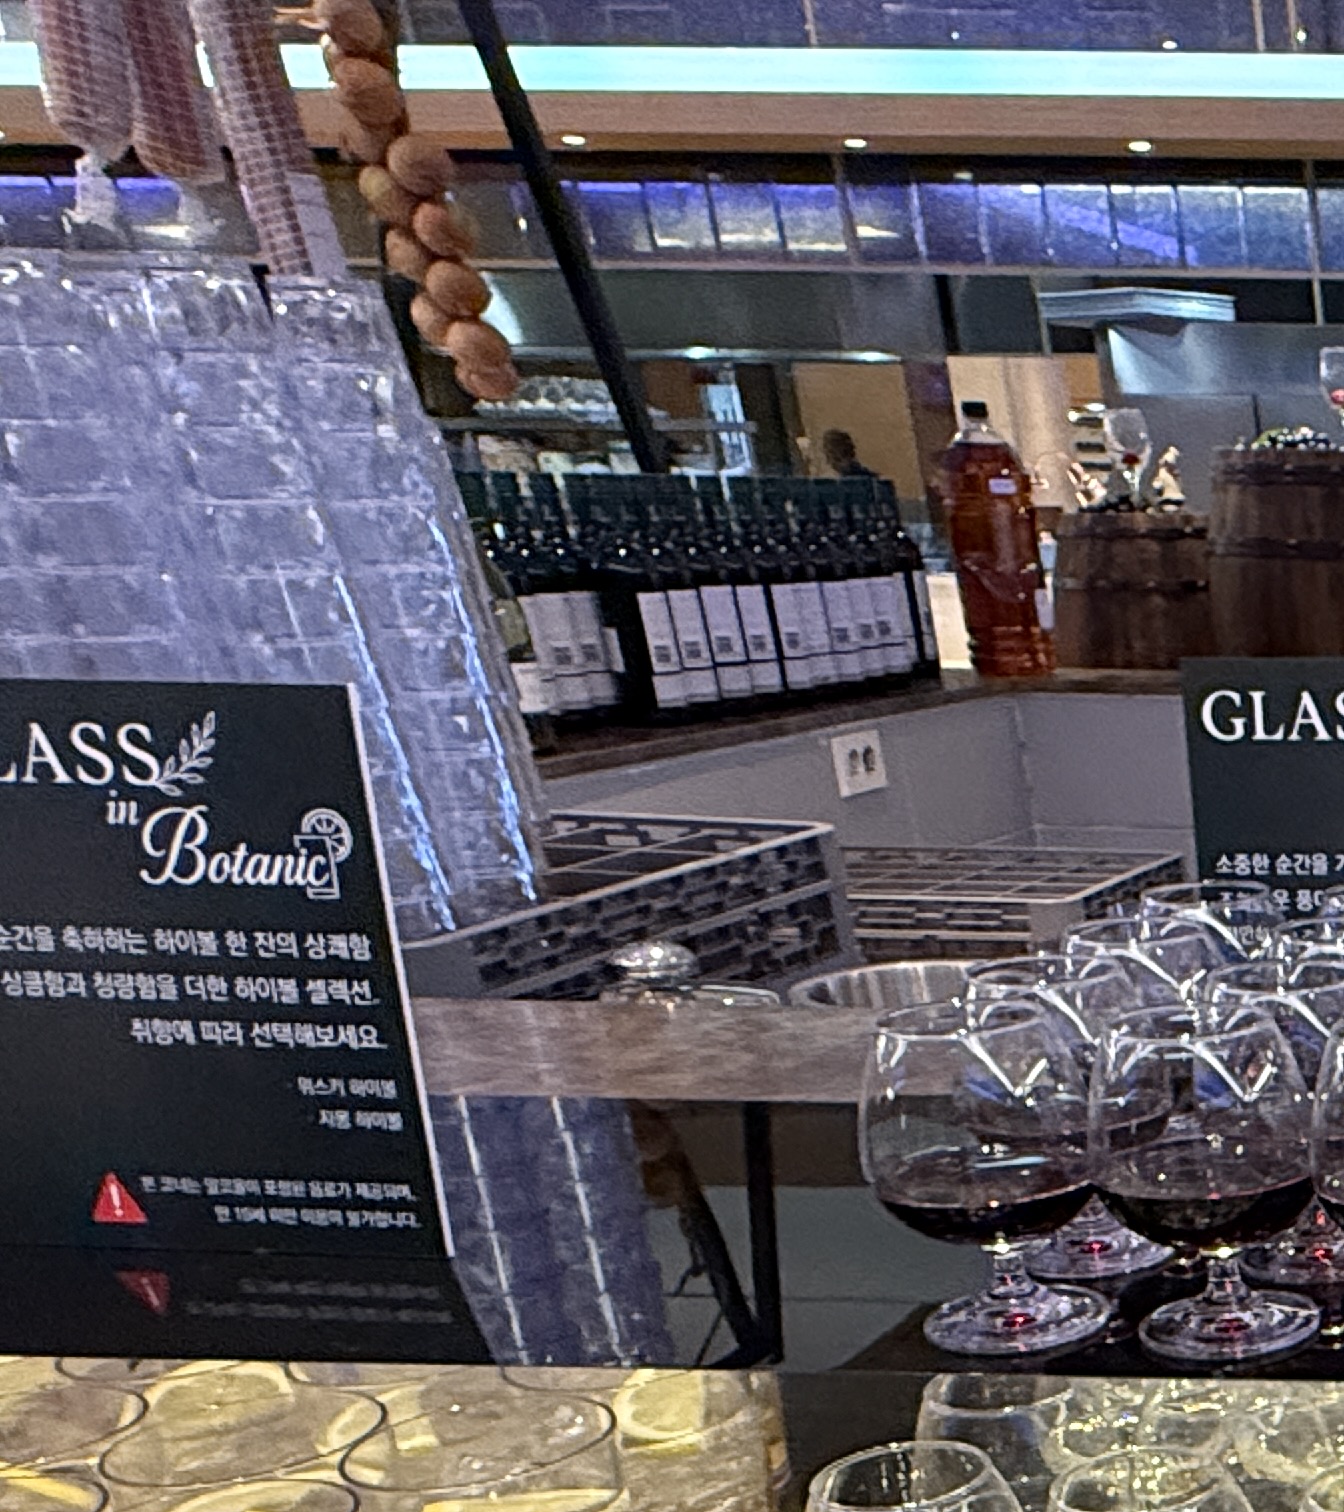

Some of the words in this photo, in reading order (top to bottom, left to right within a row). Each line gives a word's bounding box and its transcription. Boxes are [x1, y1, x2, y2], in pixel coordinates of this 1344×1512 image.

[105, 790, 140, 825] in
[139, 804, 331, 886] Botanic
[1216, 853, 1270, 876] 소중한
[1275, 853, 1328, 876] 순간을
[62, 925, 148, 955] 축하하는
[154, 928, 220, 957] 하이볼
[224, 930, 249, 958] 한
[253, 931, 299, 959] 잔의
[184, 974, 230, 1001] 더한
[233, 975, 300, 1004] 하이볼
[200, 1020, 244, 1047] 따라
